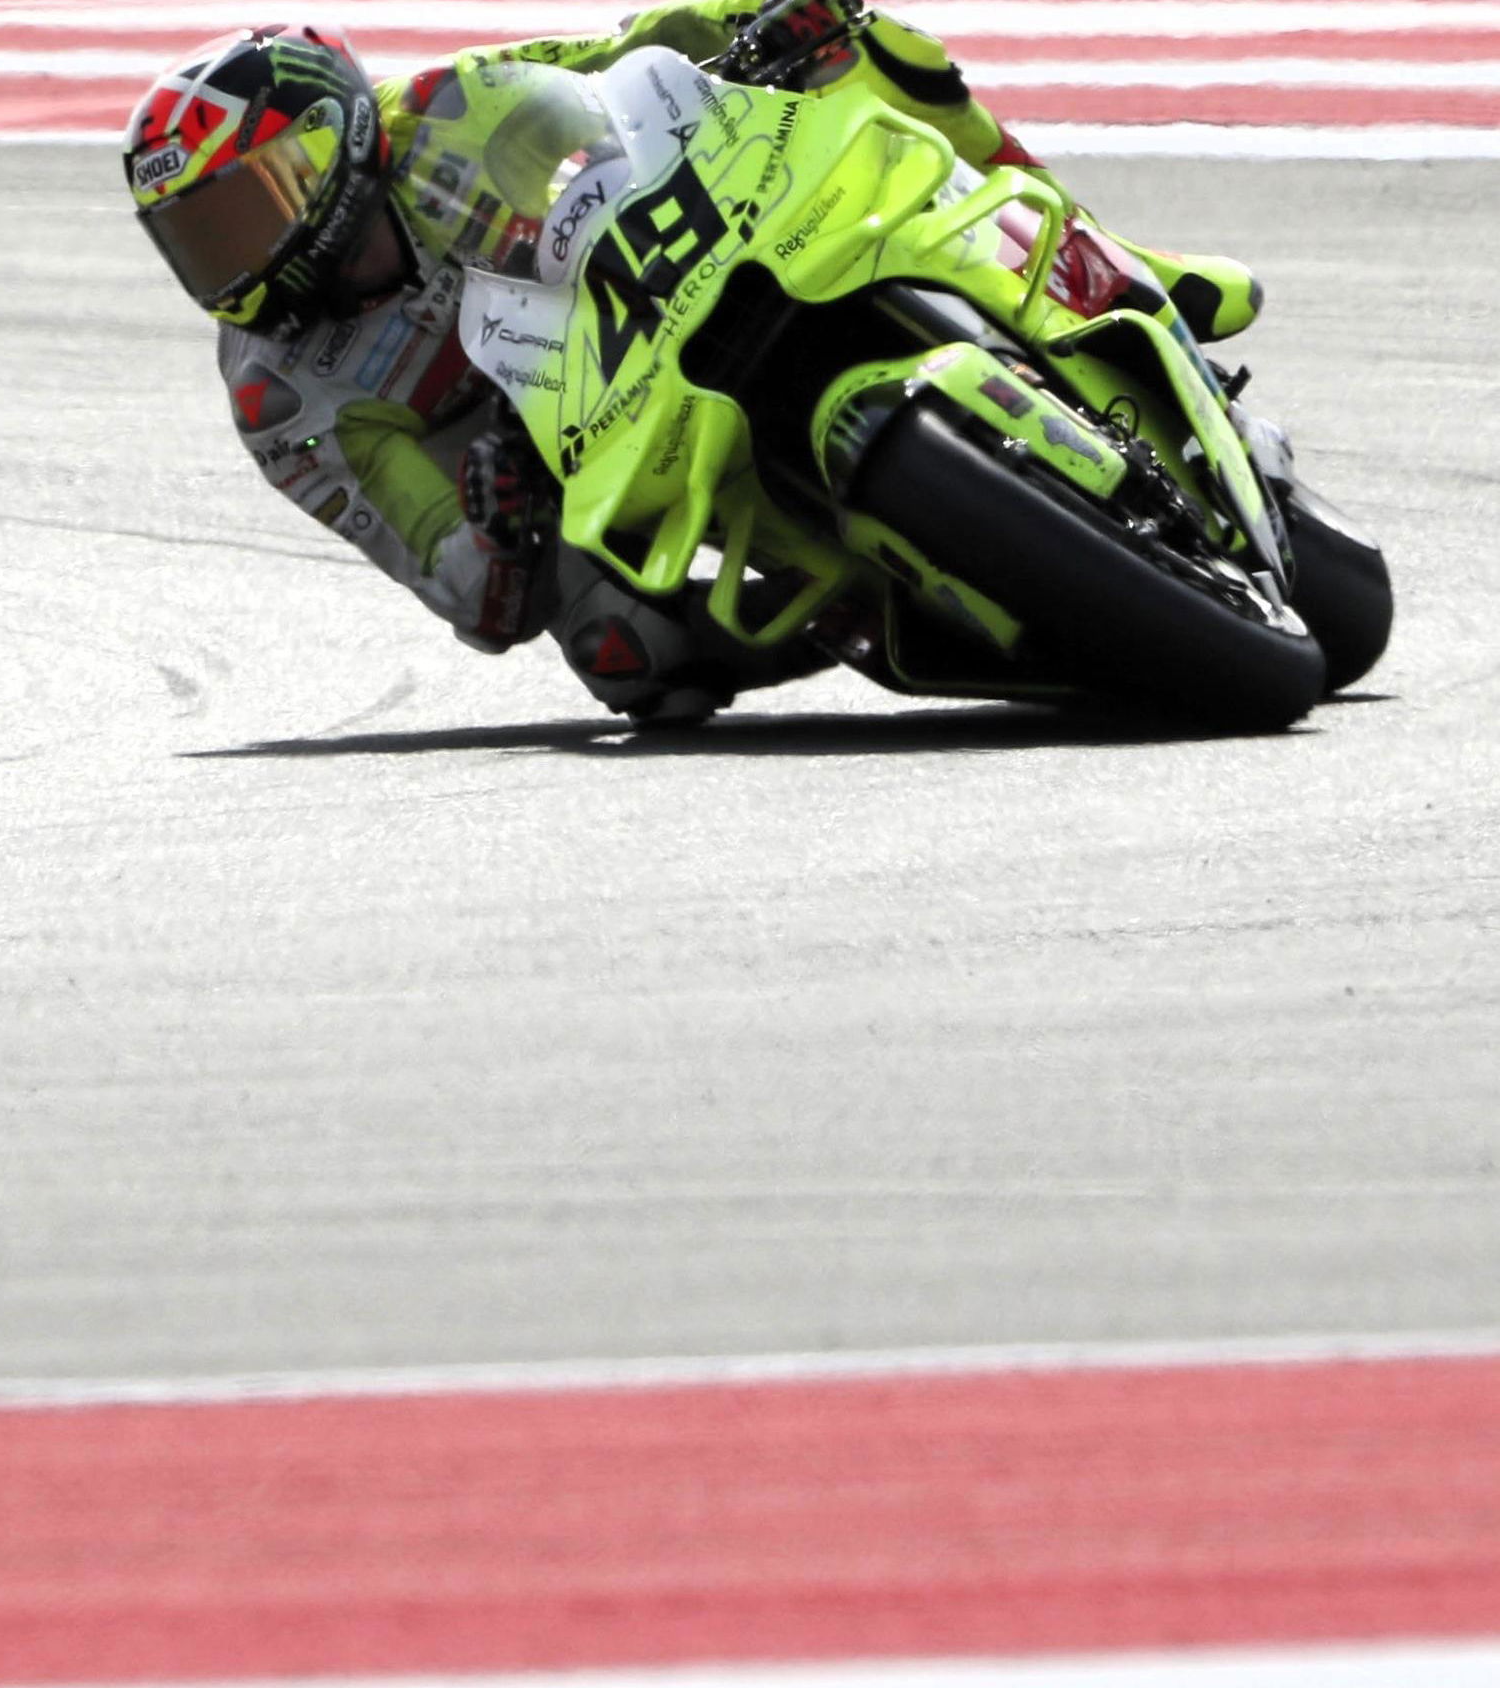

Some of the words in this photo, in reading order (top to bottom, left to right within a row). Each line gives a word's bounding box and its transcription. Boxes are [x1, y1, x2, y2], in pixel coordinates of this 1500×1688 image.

[136, 150, 180, 188] SHOEI
[756, 100, 799, 193] PERTAMINA
[552, 181, 607, 262] ebay
[585, 156, 729, 387] 49
[663, 262, 716, 336] HERO
[499, 329, 564, 353] CUPRA
[590, 360, 662, 438] PERTAMINA
